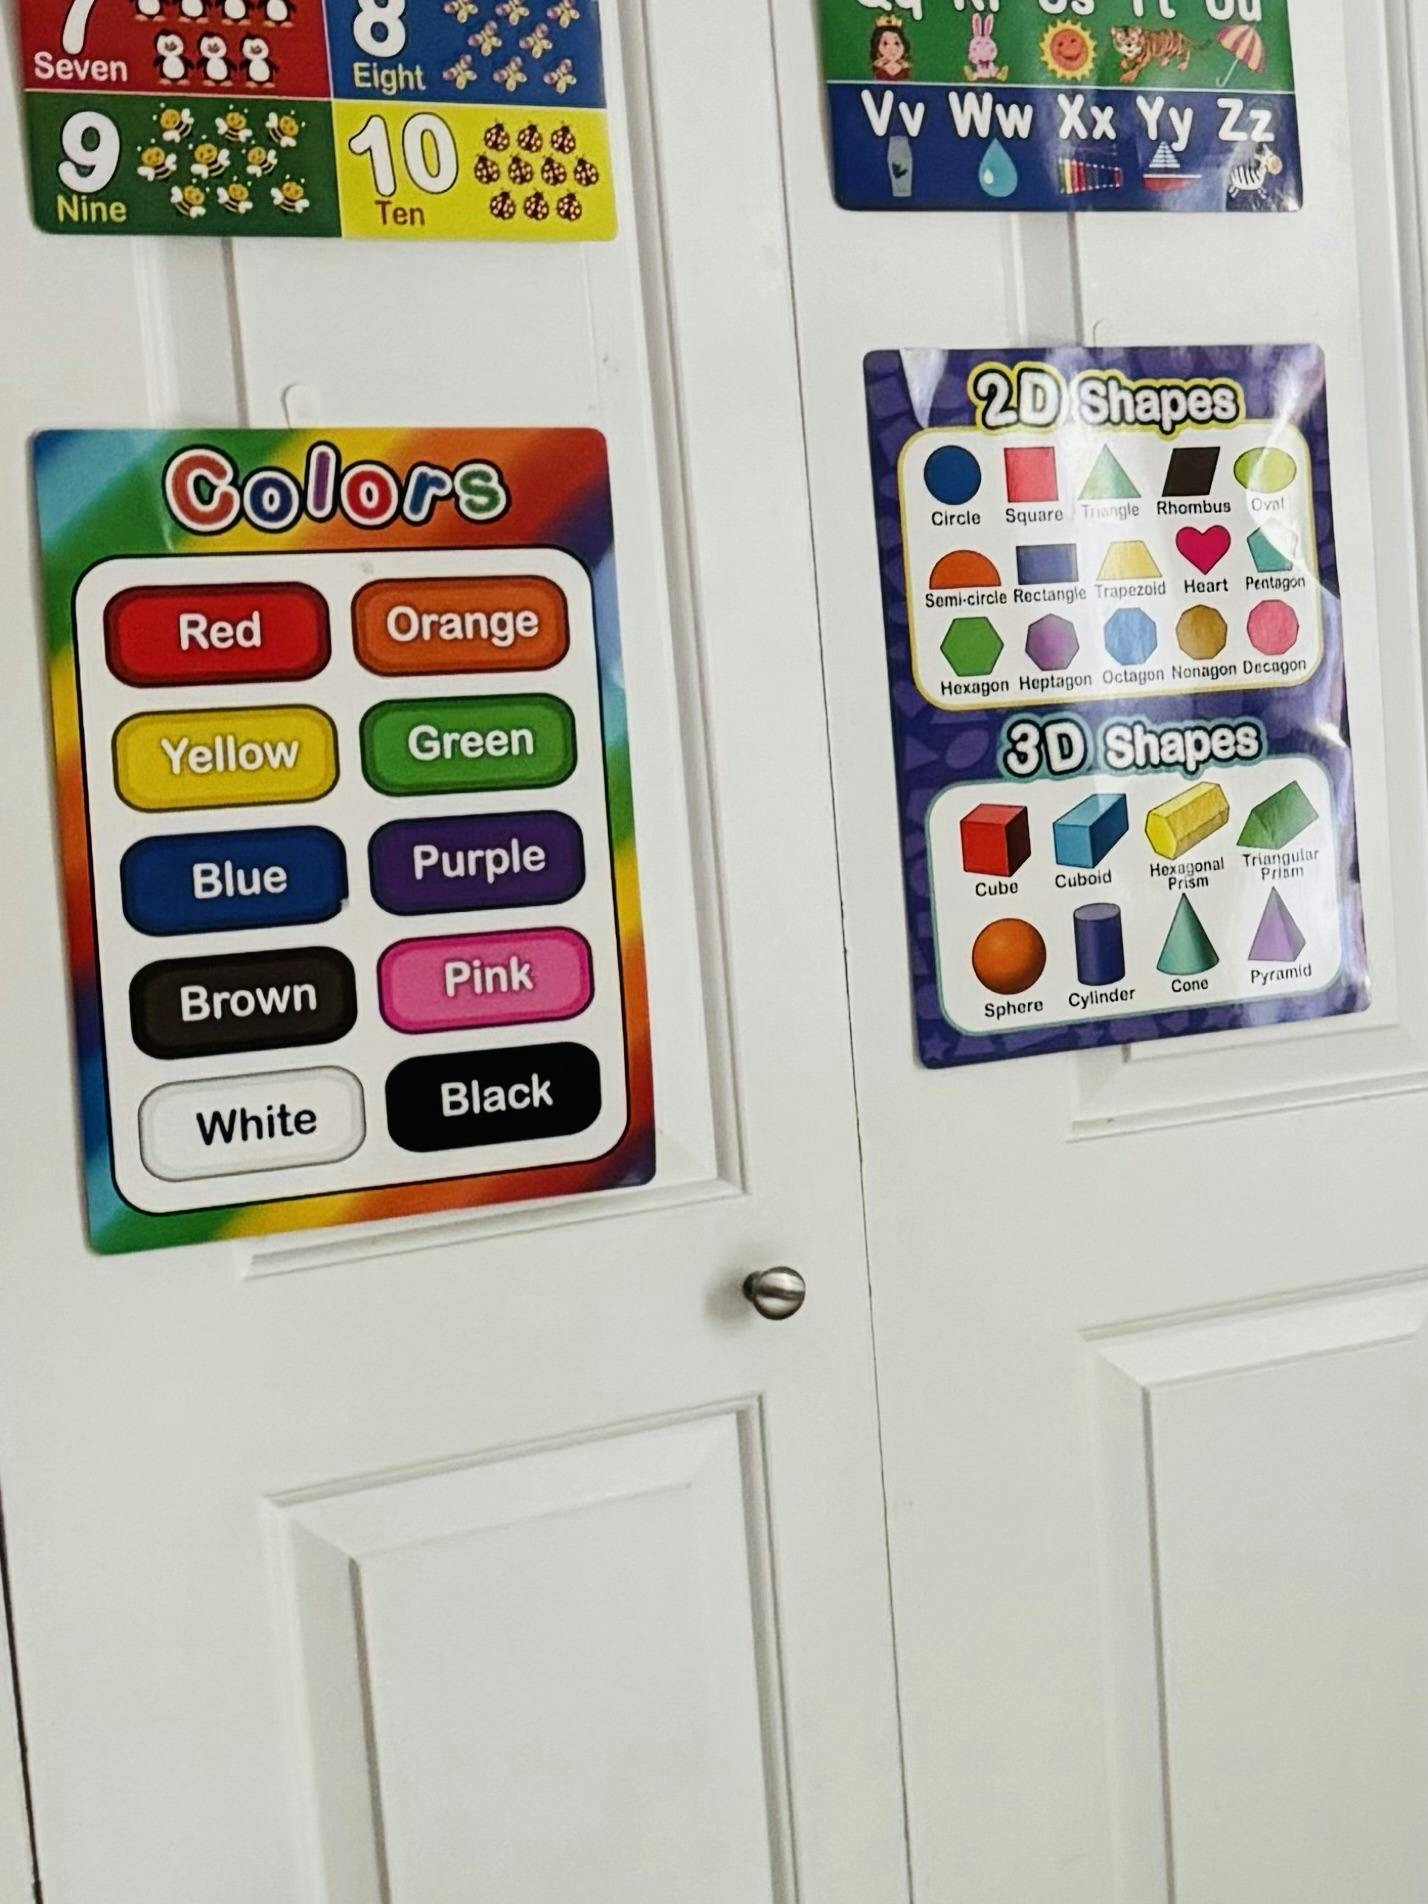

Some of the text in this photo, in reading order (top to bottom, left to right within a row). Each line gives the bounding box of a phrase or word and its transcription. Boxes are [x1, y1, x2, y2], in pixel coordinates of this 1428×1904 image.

[35, 52, 128, 84] Seven
[352, 61, 426, 94] Eight
[862, 91, 1275, 150] Vv Ww Xx Yy Zz
[58, 111, 121, 194] 9
[348, 111, 458, 197] 10
[56, 194, 127, 225] Nine
[374, 201, 426, 227] Ten
[975, 367, 1238, 434] 2D Shapes
[163, 442, 511, 535] Colors
[931, 510, 981, 526] Circle
[1005, 508, 1064, 525] Square
[1157, 501, 1231, 515] Rhombus
[926, 576, 1306, 608] Semi-circle Rectangle Trapezoid Heart Pentagon
[178, 611, 262, 651] Red
[386, 605, 540, 647] Orange
[940, 658, 1307, 697] Hexagon Heptagon Octagon Nonagon Decagon
[161, 735, 300, 777] Yellow
[407, 723, 535, 764] Green
[1003, 718, 1261, 778] 3D Shapes
[192, 860, 288, 902] Blue
[412, 839, 547, 883] Purple
[975, 849, 1320, 898] Cube Cuboid Hexagonal Triangular
[1168, 876, 1209, 891] Prism
[180, 977, 317, 1023] Brown
[444, 960, 534, 999] Pink
[984, 964, 1312, 1020] Sphere Cylinder Cone Pyramid
[440, 1074, 554, 1118] Black
[195, 1104, 317, 1149] White
